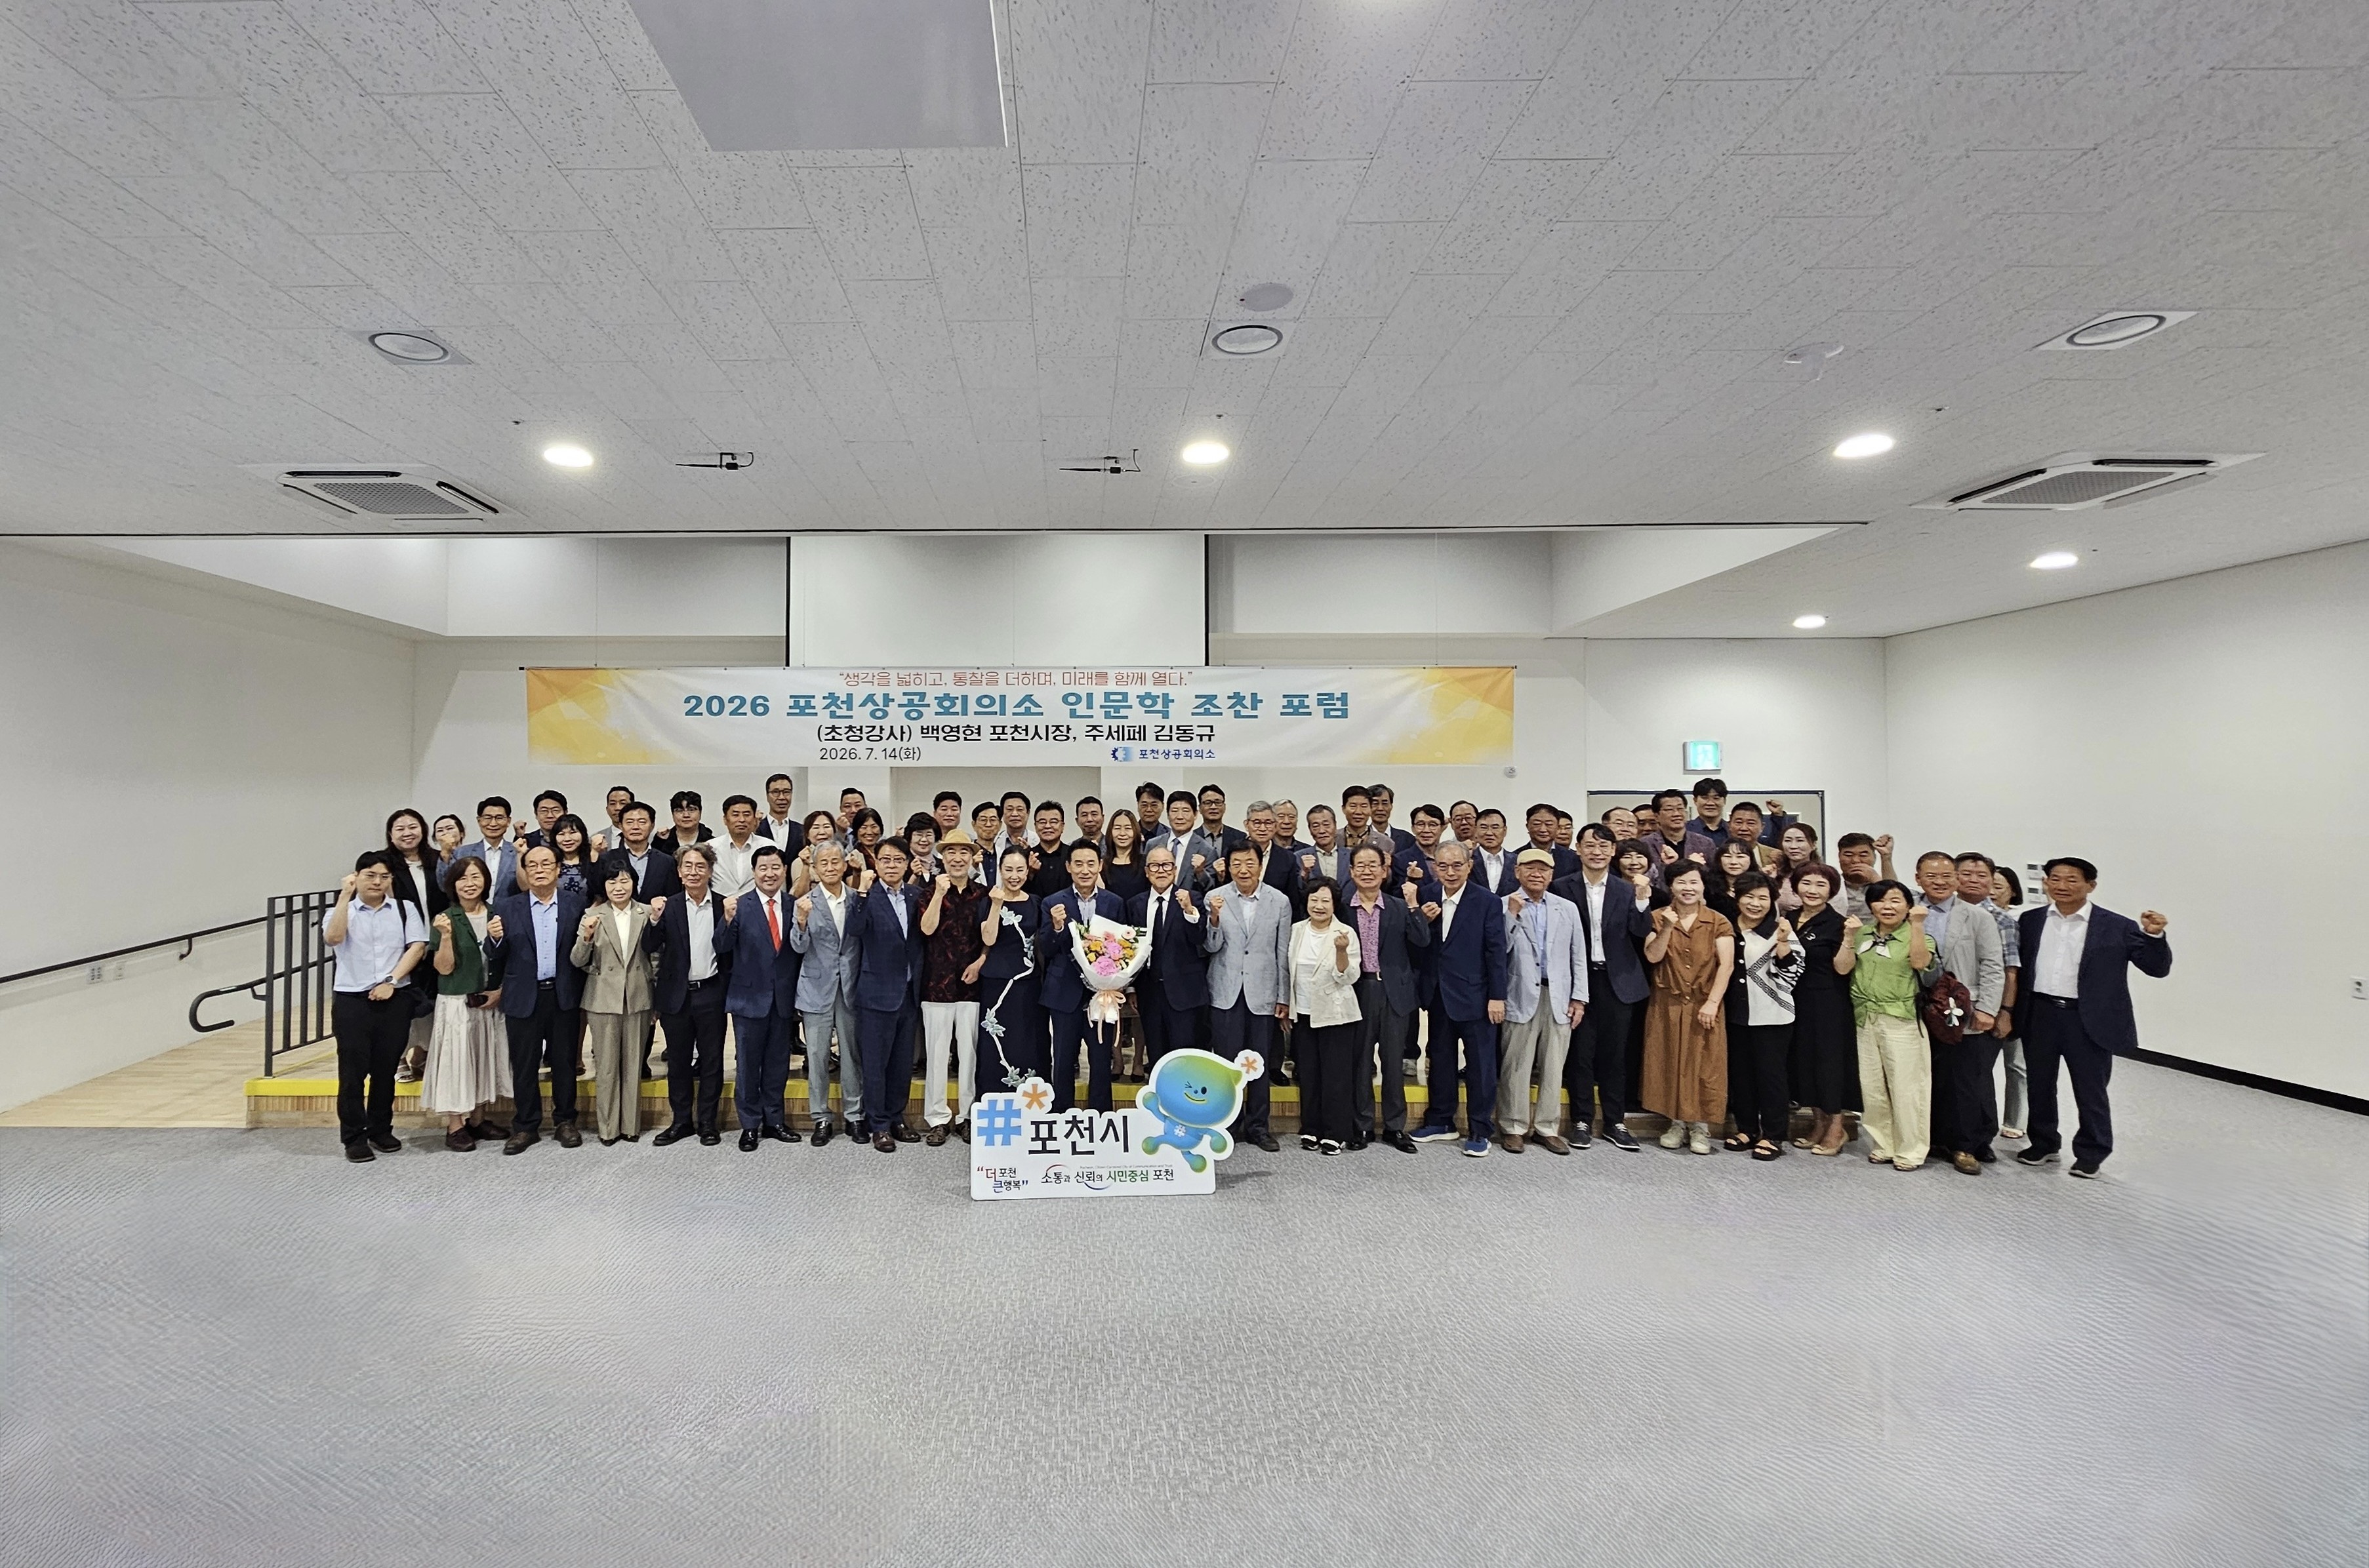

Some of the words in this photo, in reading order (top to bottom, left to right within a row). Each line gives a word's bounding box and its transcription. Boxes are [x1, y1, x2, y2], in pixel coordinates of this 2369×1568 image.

[897, 672, 948, 687] 넓히고,
[952, 671, 1000, 687] 통찰을
[1005, 671, 1056, 687] 더하며,
[1062, 671, 1109, 686] 미래를
[1114, 671, 1146, 687] 함께
[683, 694, 771, 717] 2026
[786, 691, 1044, 721] 포천상공회의소
[1061, 691, 1175, 720] 인문학
[1190, 691, 1264, 719] 조찬
[1280, 692, 1348, 719] 포럼
[817, 724, 912, 743] (초청강사)
[920, 724, 982, 742] 백영현
[989, 724, 1077, 742] 포천시장,
[1084, 724, 1146, 742] 주세페
[1153, 725, 1215, 742] 김동규
[1139, 748, 1216, 760] 포천상공회의소
[998, 1167, 1017, 1178] 포천
[1041, 1171, 1071, 1184] 소통과
[1074, 1171, 1103, 1184] 신뢰의
[1106, 1169, 1149, 1182] 시민중심
[1152, 1169, 1175, 1181] 포천
